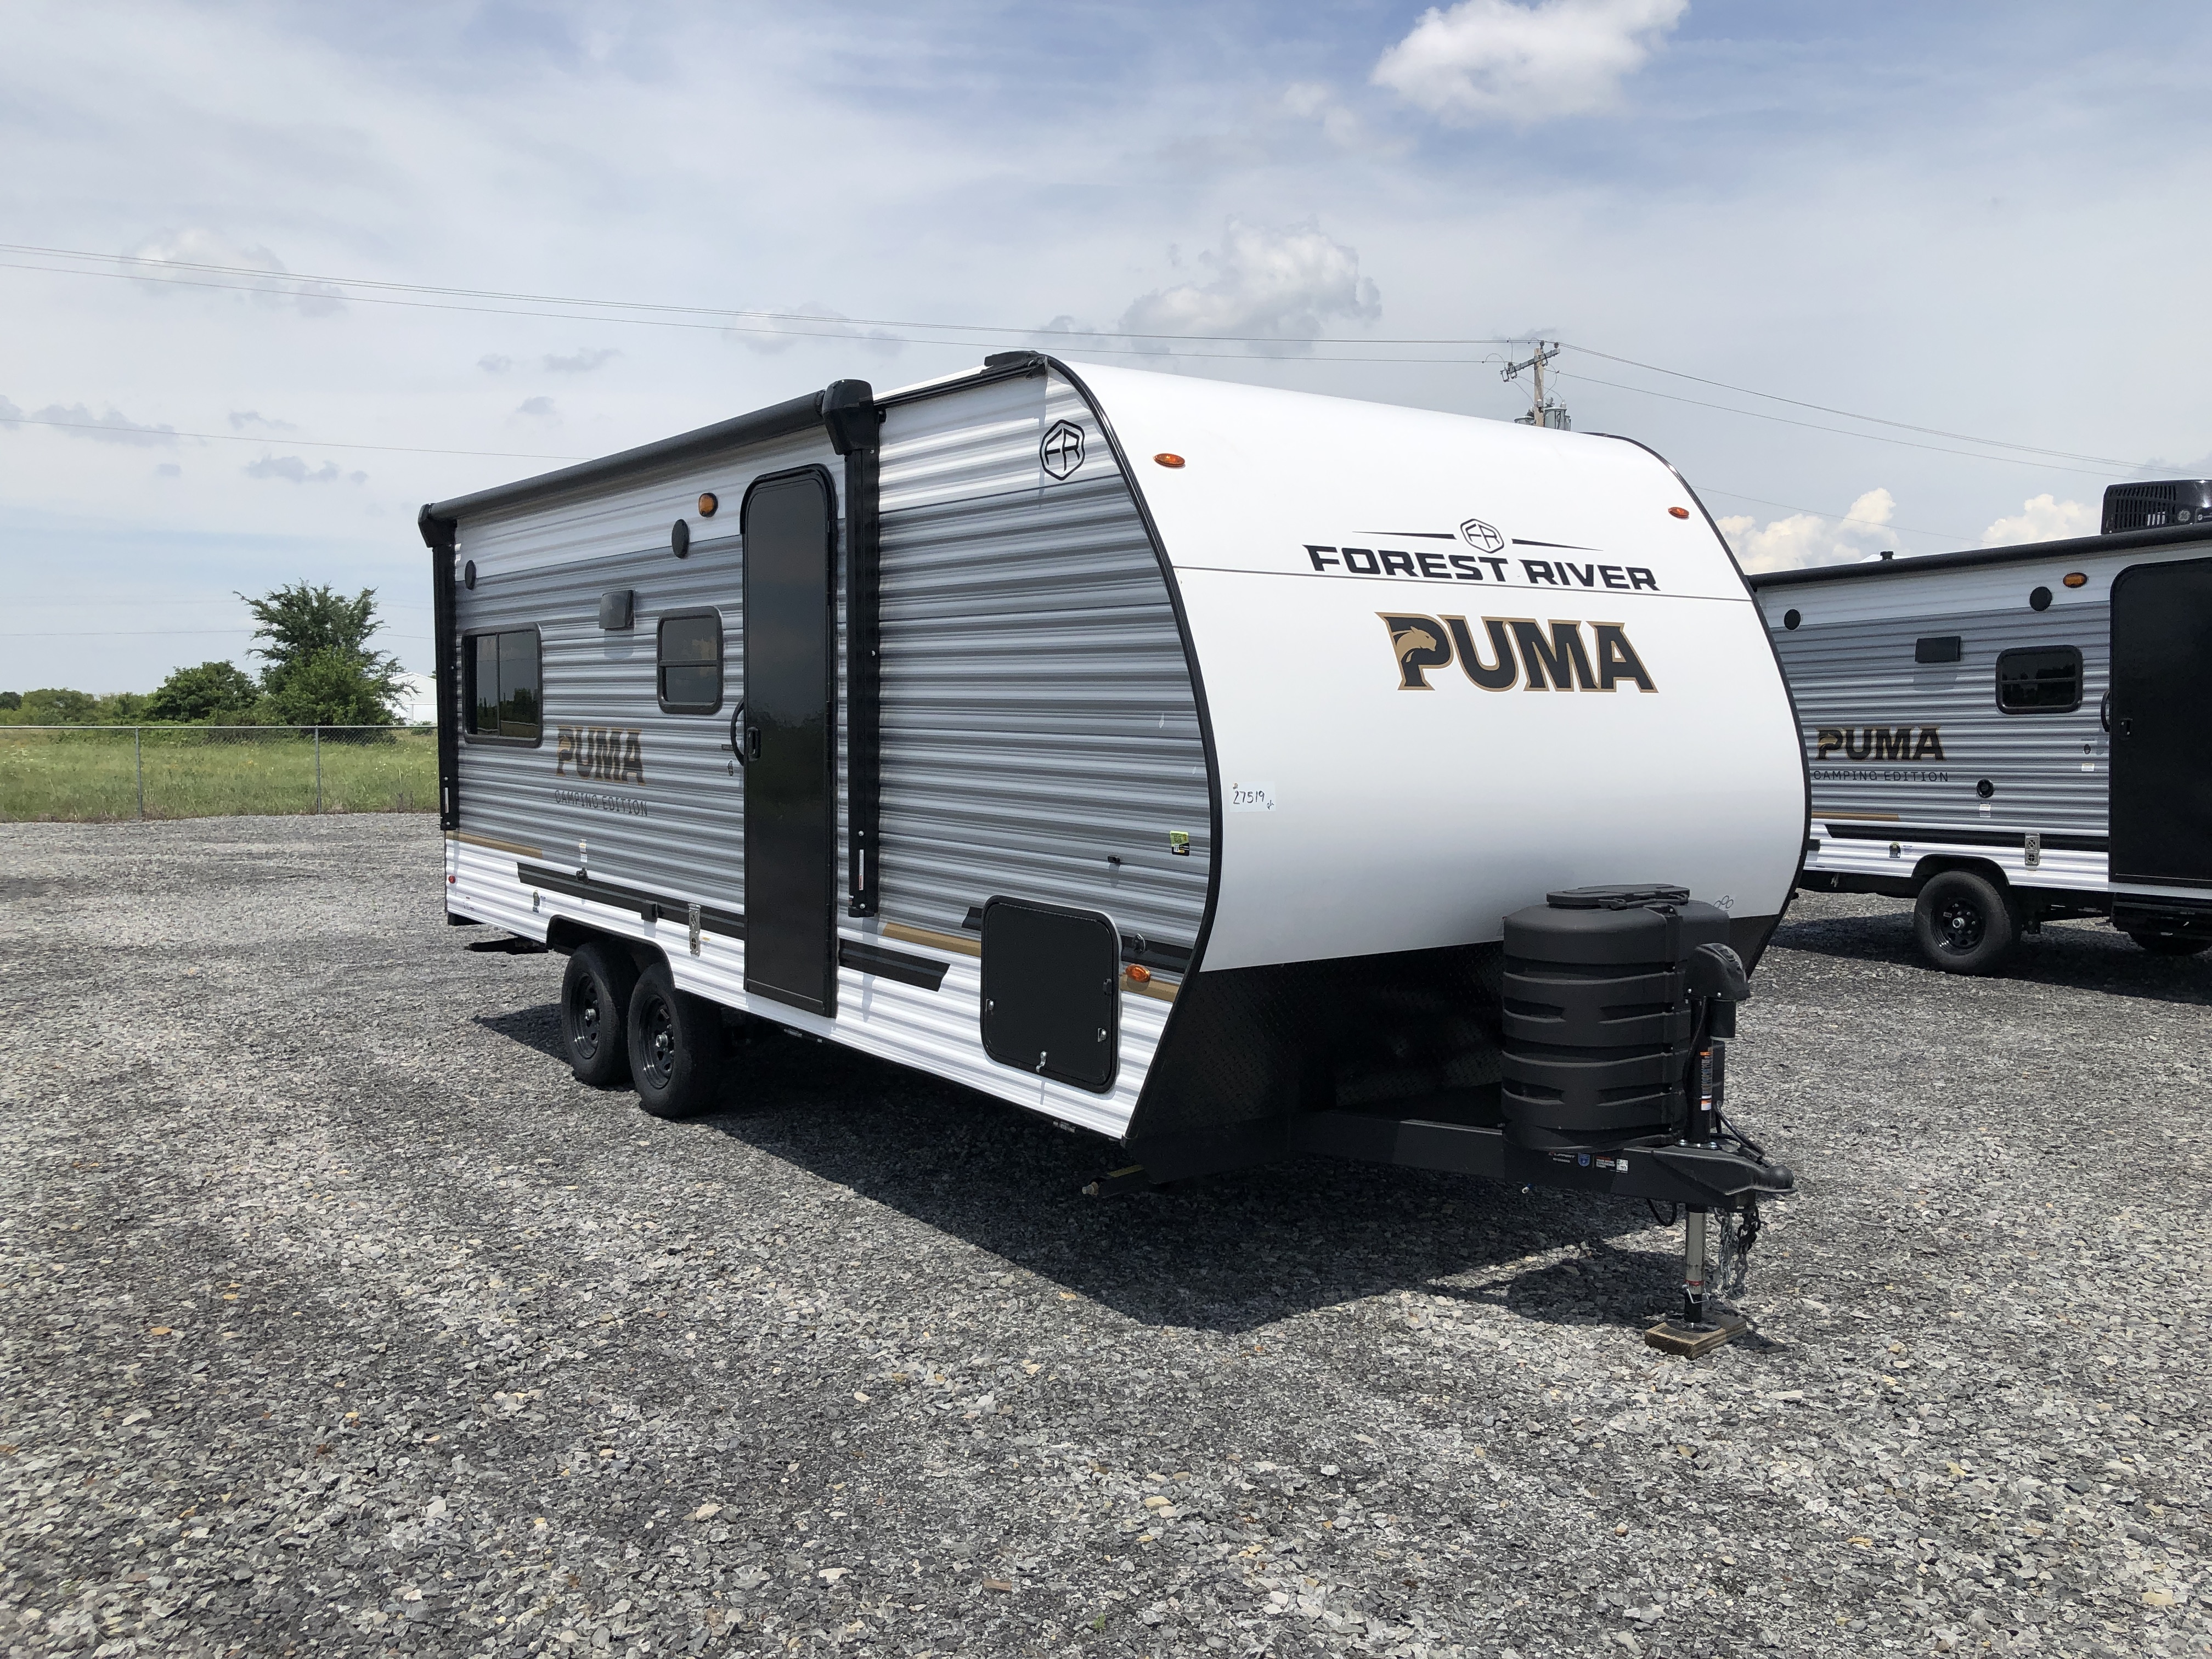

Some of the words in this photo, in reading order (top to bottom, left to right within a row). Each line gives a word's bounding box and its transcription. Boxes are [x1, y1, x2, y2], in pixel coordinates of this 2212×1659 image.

[1302, 544, 1509, 582] FOREST
[1518, 558, 1662, 591] RIVER
[1374, 612, 1660, 693] PUMA
[556, 725, 646, 786] PUMA
[1815, 725, 1947, 761] PUMA
[1813, 770, 1877, 781] CAMPING
[1884, 771, 1948, 782] EDITION
[555, 789, 599, 809] CAMPING
[602, 795, 648, 816] EDITION
[1233, 790, 1265, 805] 27519
